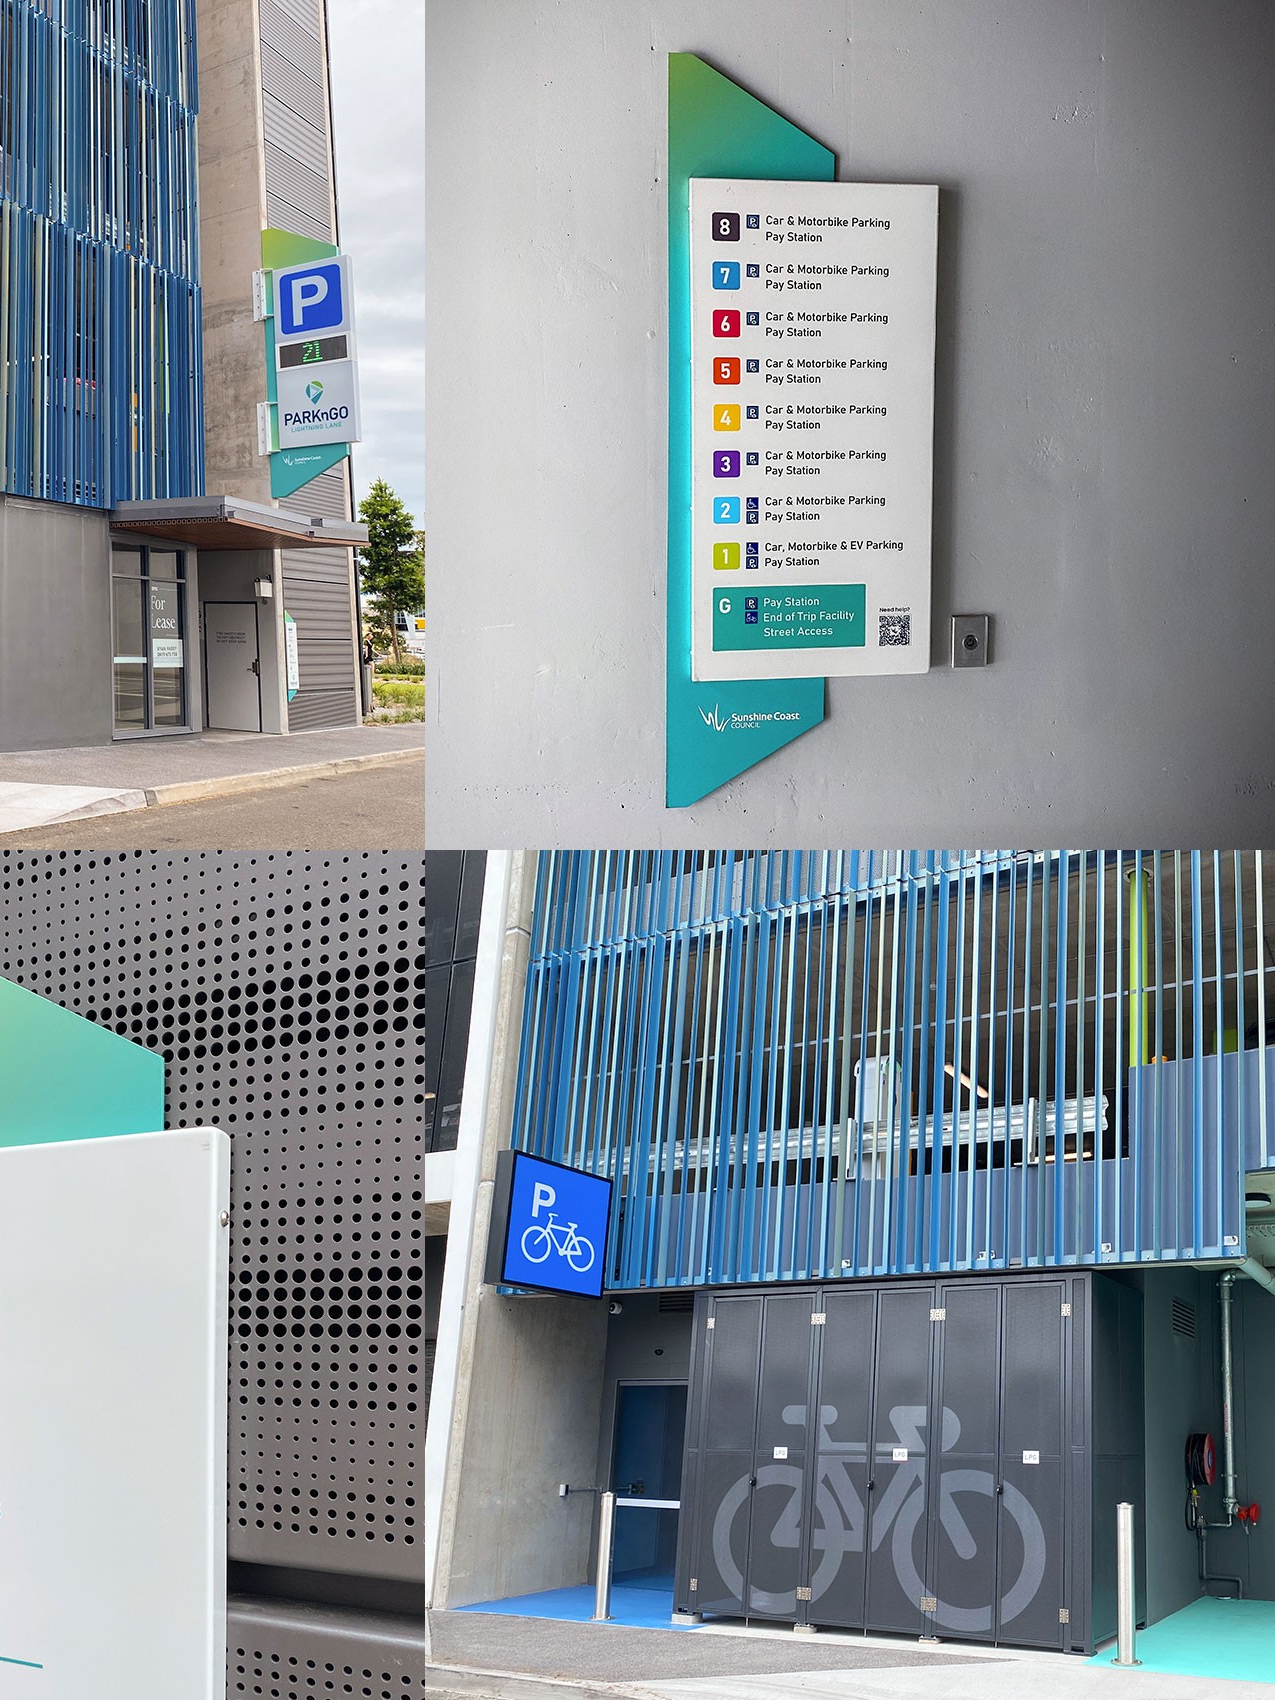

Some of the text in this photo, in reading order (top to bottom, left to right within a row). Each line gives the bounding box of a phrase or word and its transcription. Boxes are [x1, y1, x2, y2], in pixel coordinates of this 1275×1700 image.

[719, 218, 730, 235] 8
[765, 216, 890, 230] Car & Motorbike Parking
[765, 232, 822, 243] Pay Station
[720, 268, 730, 284] 7
[765, 264, 889, 277] Car & Motorbike Parking
[765, 280, 822, 291] Pay Station
[291, 275, 328, 326] P
[720, 316, 730, 332] 6
[765, 312, 888, 324] Car & Motorbike Parking
[765, 328, 822, 338] Pay Station
[302, 340, 323, 362] 21
[765, 359, 887, 370] Car & Motorbike Parking
[721, 363, 730, 379] 5
[765, 374, 821, 385] Pay Station
[284, 406, 349, 426] PARKnGO
[765, 405, 887, 416] Car & Motorbike Parking
[720, 410, 731, 426] 4
[291, 421, 342, 432] LIGHTNING LANE
[765, 420, 820, 431] Pay Station
[765, 450, 886, 461] Car & Motorbike Parking
[721, 456, 731, 472] 3
[765, 466, 820, 477] Pay Station
[765, 496, 886, 507] Car & Motorbike Parking
[721, 503, 730, 518] 2
[765, 512, 820, 523] Pay Station
[765, 540, 903, 552] Car, Motorbike & EV Parking
[722, 548, 728, 564] 1
[765, 557, 819, 569] Pay Station
[151, 595, 165, 610] For
[719, 598, 731, 613] G
[764, 597, 819, 609] Pay Station
[151, 613, 176, 629] Lease
[764, 611, 854, 623] End of Trip Facility
[764, 626, 833, 637] Street Access
[731, 712, 800, 721] Sunshine Coast
[532, 1182, 556, 1218] P
